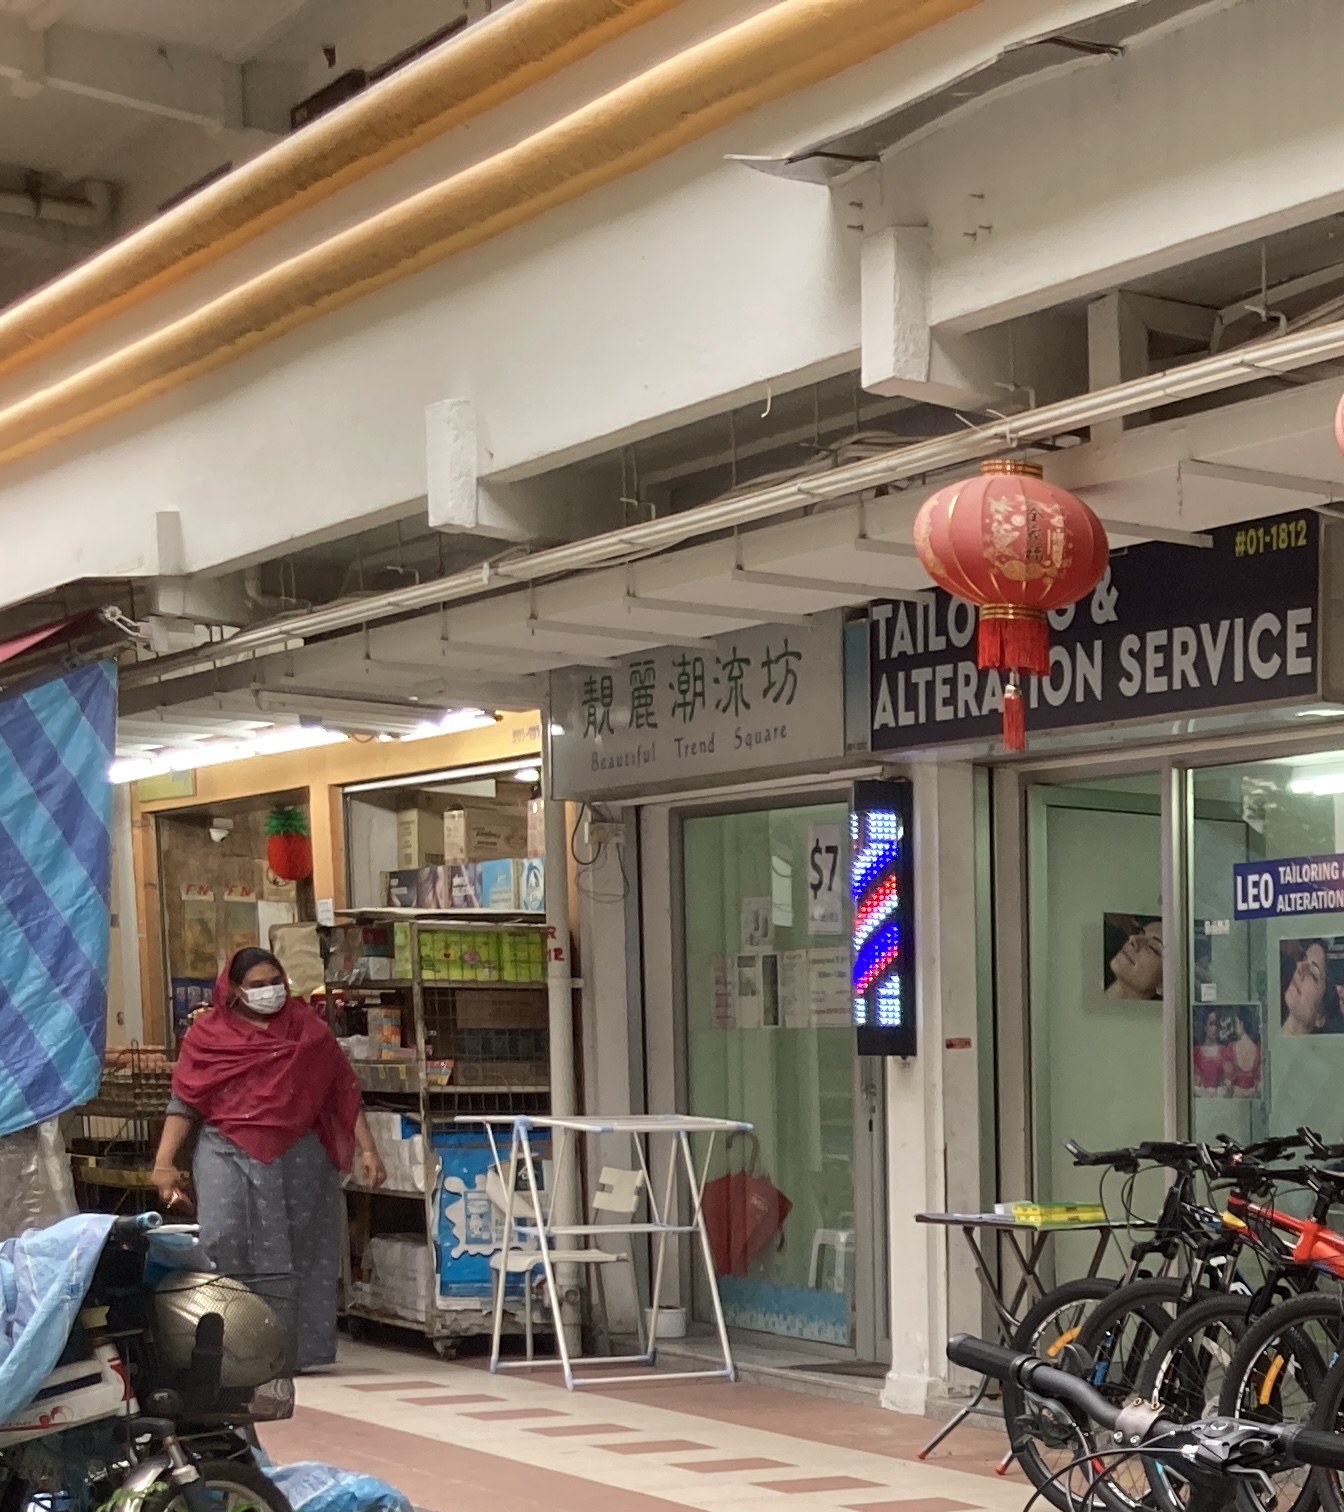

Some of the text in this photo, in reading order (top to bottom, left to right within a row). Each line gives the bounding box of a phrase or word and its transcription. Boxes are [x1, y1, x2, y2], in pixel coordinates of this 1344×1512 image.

[1235, 519, 1308, 558] #01-1812
[873, 607, 1313, 731] ALTERAION SERVICE
[674, 732, 716, 759] Trend
[734, 725, 788, 751] Square
[810, 838, 839, 899] $7
[1278, 862, 1340, 885] TAILORING
[1236, 873, 1275, 912] LEO
[1277, 891, 1344, 913] ALTERATION
